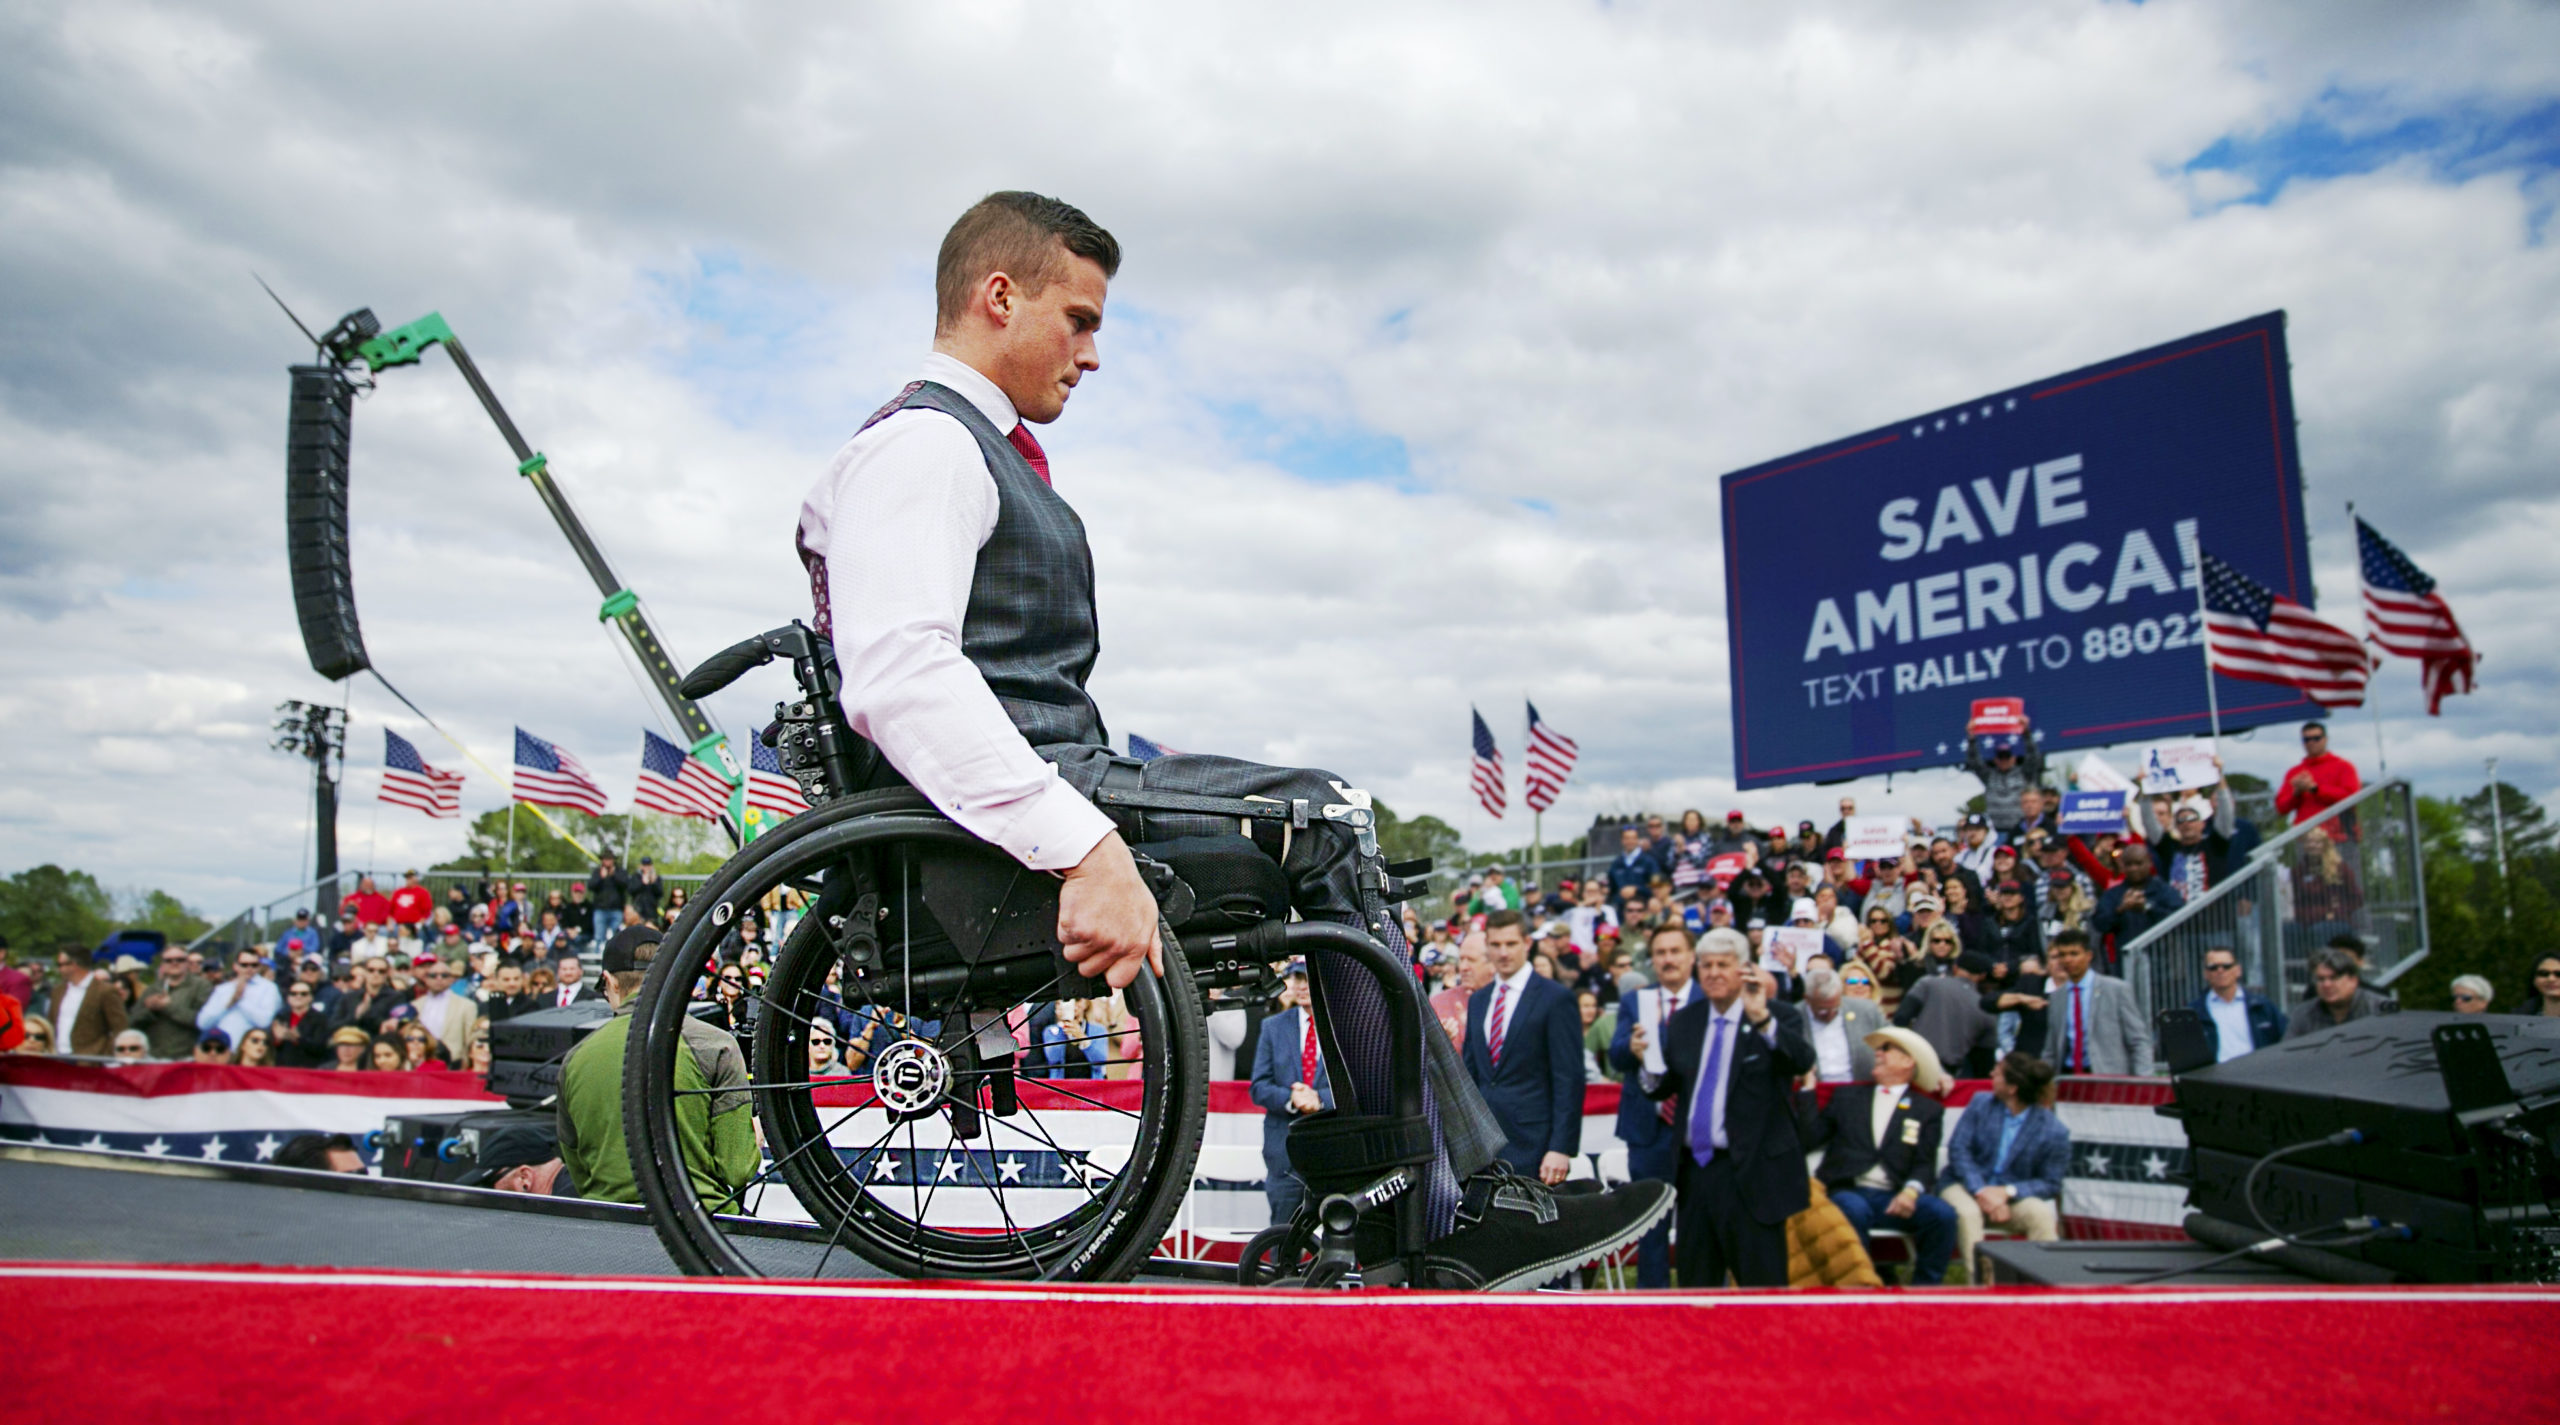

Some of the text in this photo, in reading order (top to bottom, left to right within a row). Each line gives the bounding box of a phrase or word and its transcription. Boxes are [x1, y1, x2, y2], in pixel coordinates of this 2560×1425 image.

[1878, 453, 2088, 561] SAVE
[1803, 517, 2199, 662] AMERICA!
[1802, 667, 1885, 709] TEXT
[1894, 644, 2008, 694] RALLY
[2017, 633, 2072, 673] TO
